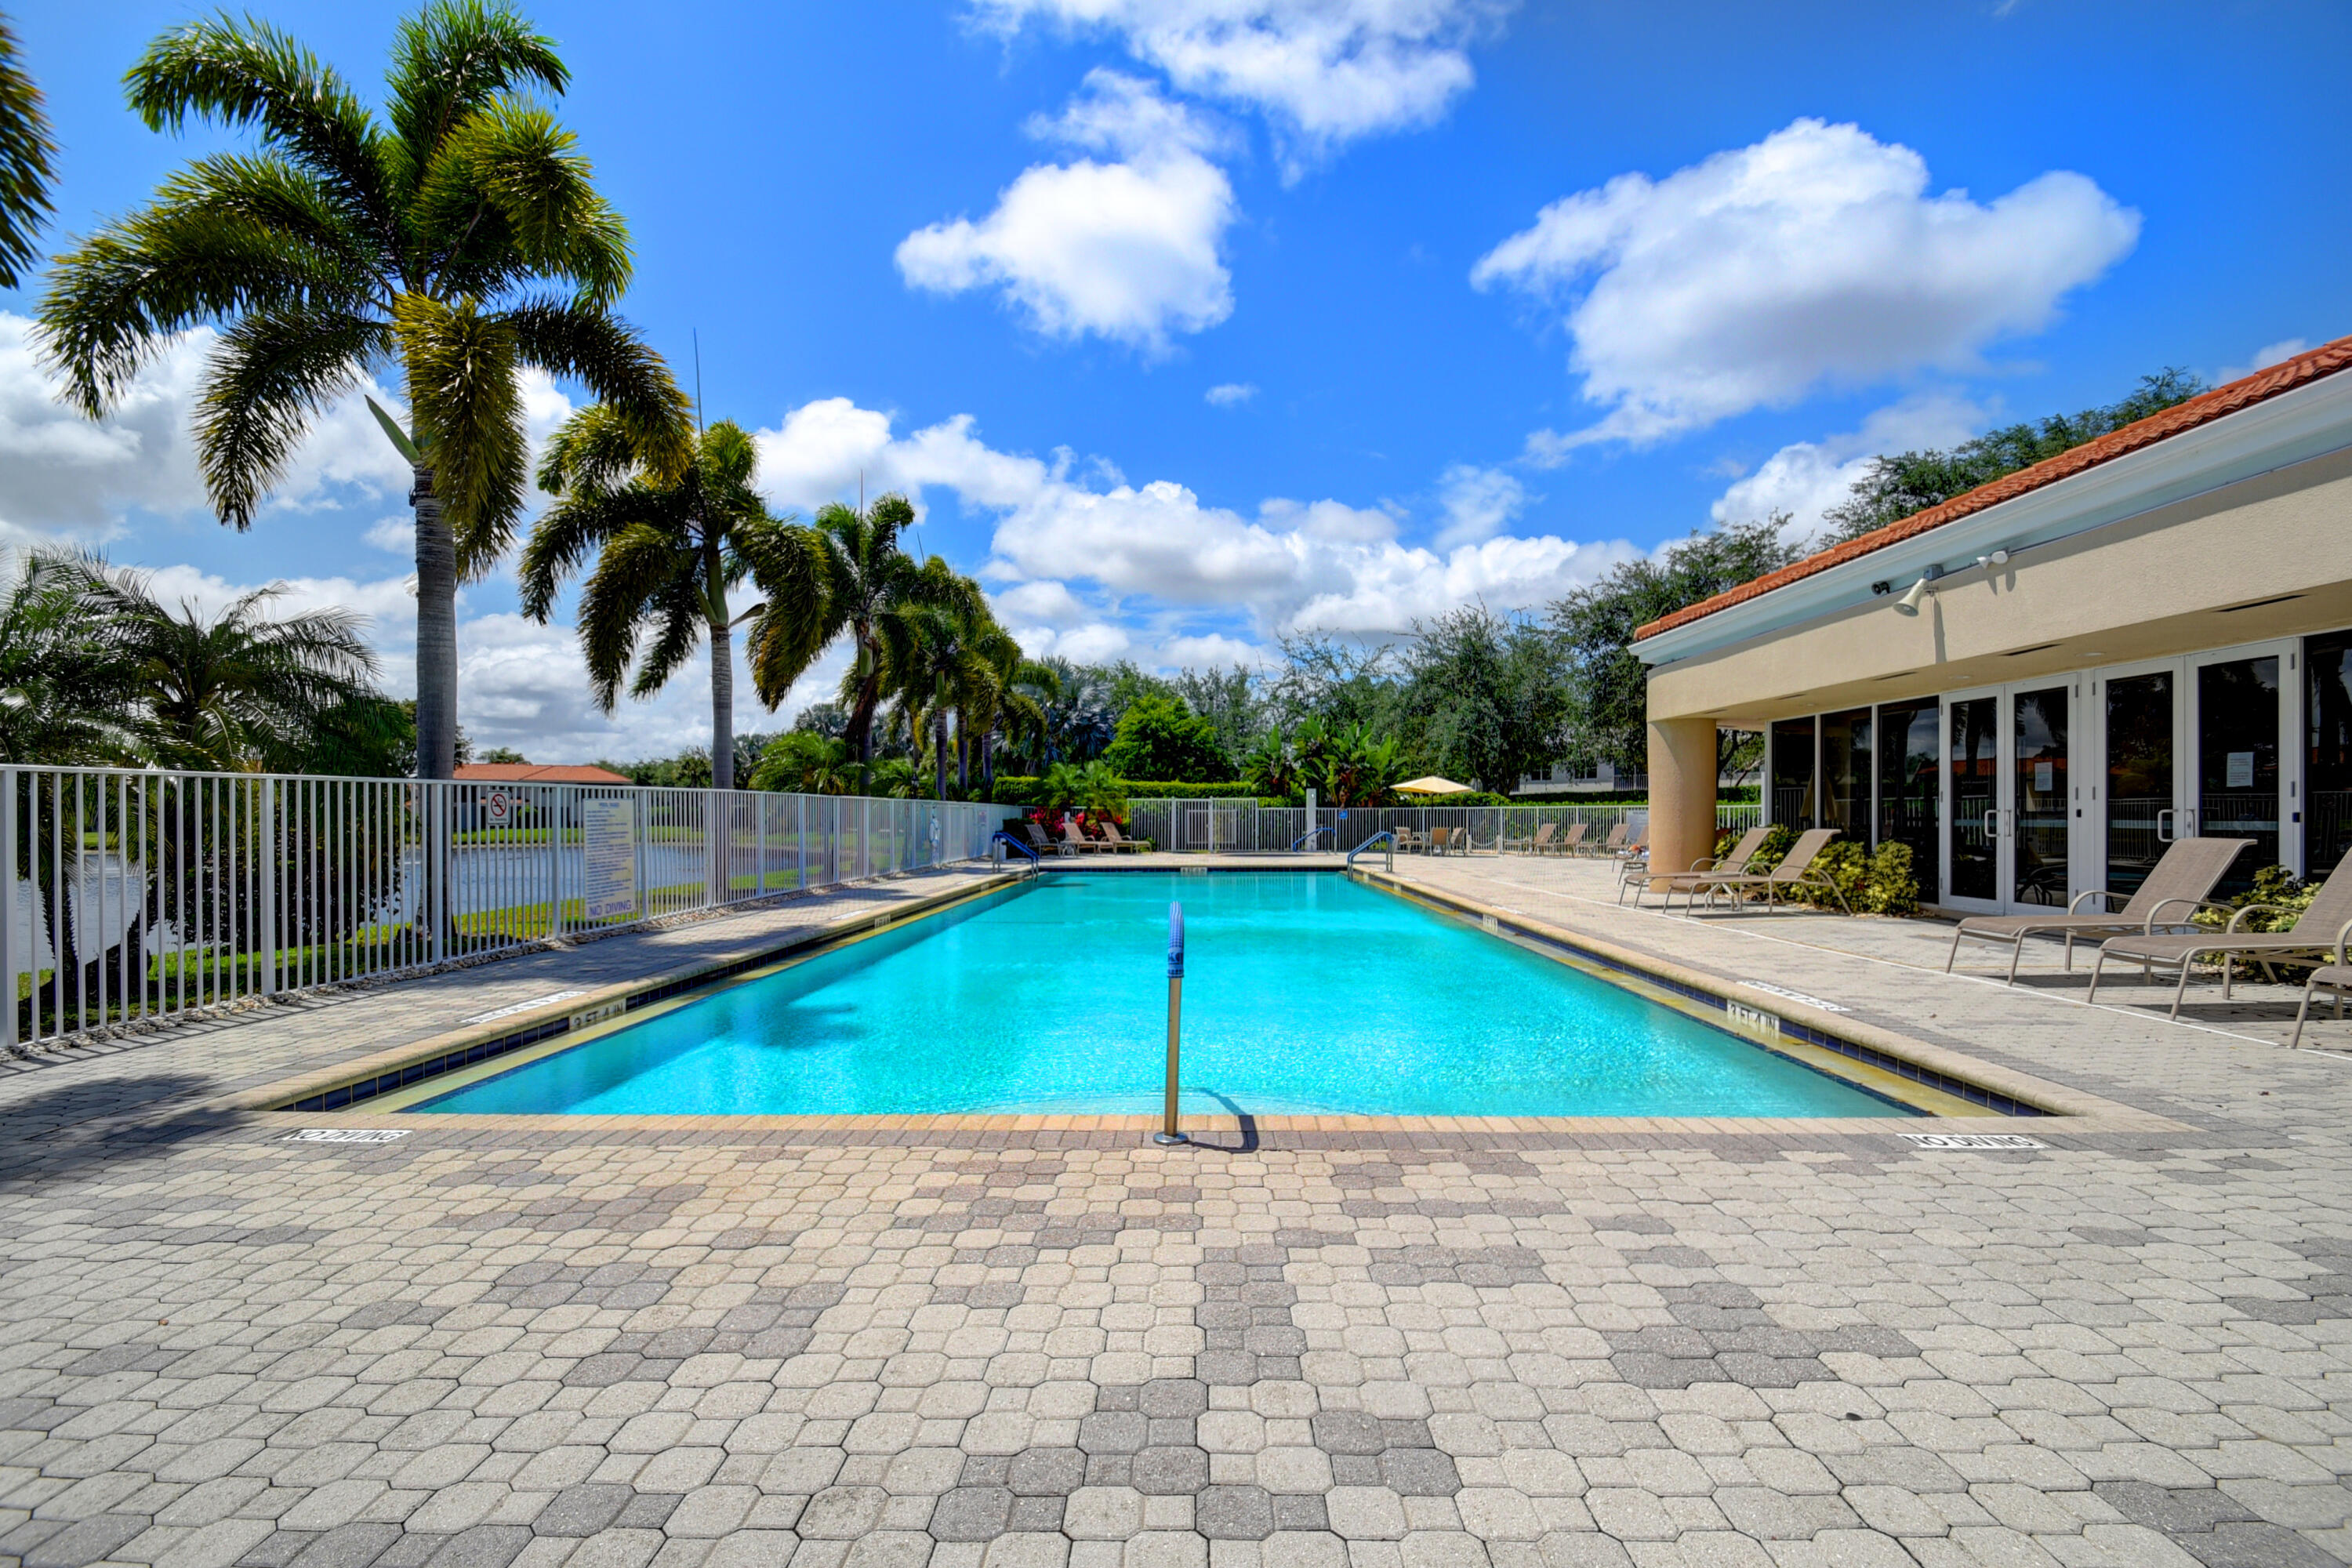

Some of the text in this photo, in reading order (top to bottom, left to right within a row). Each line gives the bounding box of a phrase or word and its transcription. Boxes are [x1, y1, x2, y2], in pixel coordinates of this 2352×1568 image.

[590, 899, 632, 916] NO DIVING
[1740, 1007, 1751, 1022] FT
[1766, 1015, 1776, 1030] IN
[320, 1131, 403, 1141] DIVING
[1901, 1136, 2034, 1147] NO DIVING
